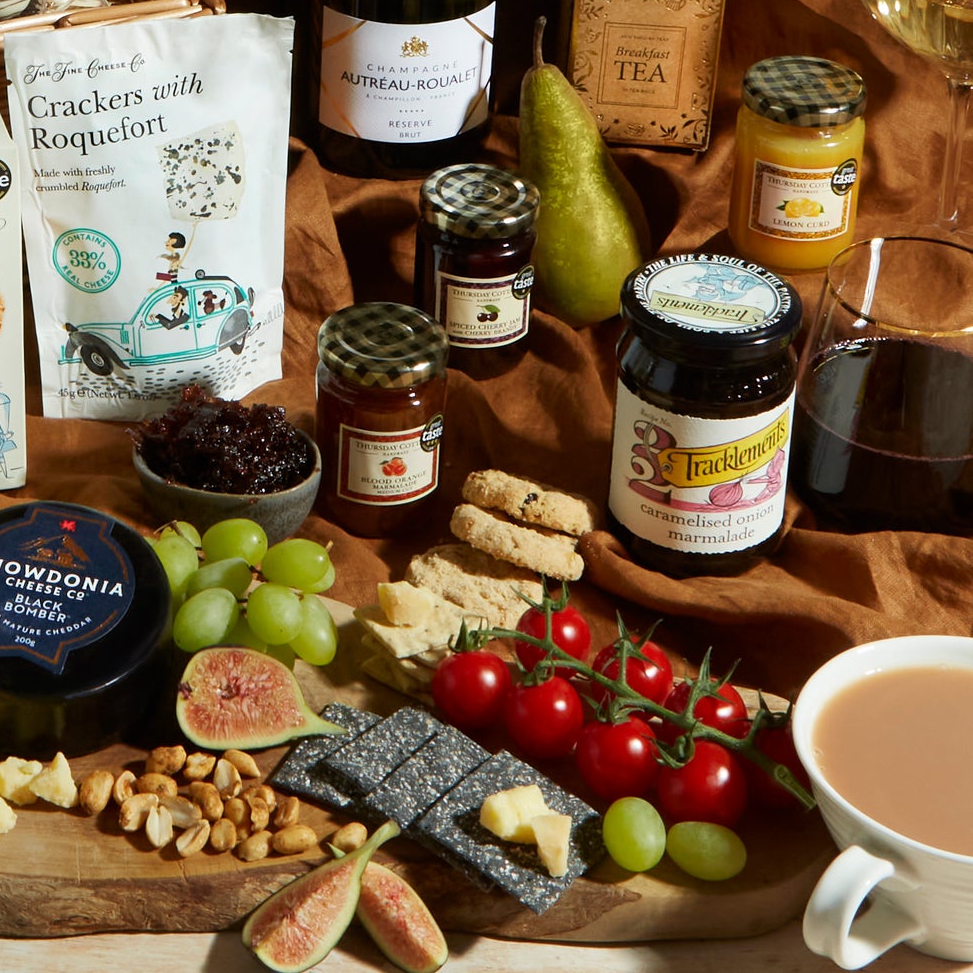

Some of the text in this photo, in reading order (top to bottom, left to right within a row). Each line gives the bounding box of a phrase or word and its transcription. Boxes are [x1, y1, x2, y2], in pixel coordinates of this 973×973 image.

[615, 45, 670, 61] Breakfast
[367, 61, 458, 74] CHAMPAGNE
[614, 61, 667, 83] TEA
[341, 66, 477, 91] AUTRÉAU-ROUALET
[27, 73, 204, 119] Crackers with
[30, 114, 168, 156] Roquefort
[34, 164, 117, 179] Made with freshly
[833, 173, 857, 184] taste
[35, 181, 79, 192] crumbled
[768, 176, 808, 188] THURSDAY
[773, 218, 830, 228] LEMON CURD
[62, 233, 106, 249] CONTAINS
[69, 249, 106, 271] 33%
[62, 264, 114, 288] REAL CHEESE
[646, 259, 666, 275] THE
[669, 253, 695, 265] LIFE
[698, 253, 709, 261] &
[711, 254, 745, 269] SOUL
[747, 263, 764, 275] OF
[766, 272, 784, 289] THE
[452, 289, 490, 298] THURSDAY
[355, 441, 398, 451] THURSDAY
[667, 418, 787, 482] Tracklements
[360, 476, 392, 485] BLOOD
[641, 502, 774, 527] caramelised onion
[668, 528, 755, 544] marmalade
[5, 577, 62, 597] CHEESE
[14, 593, 63, 612] BLACK
[4, 601, 67, 624] BOMBER
[2, 618, 42, 636] MATURE
[45, 616, 93, 636] CHEDDAR
[14, 635, 36, 648] 200g
